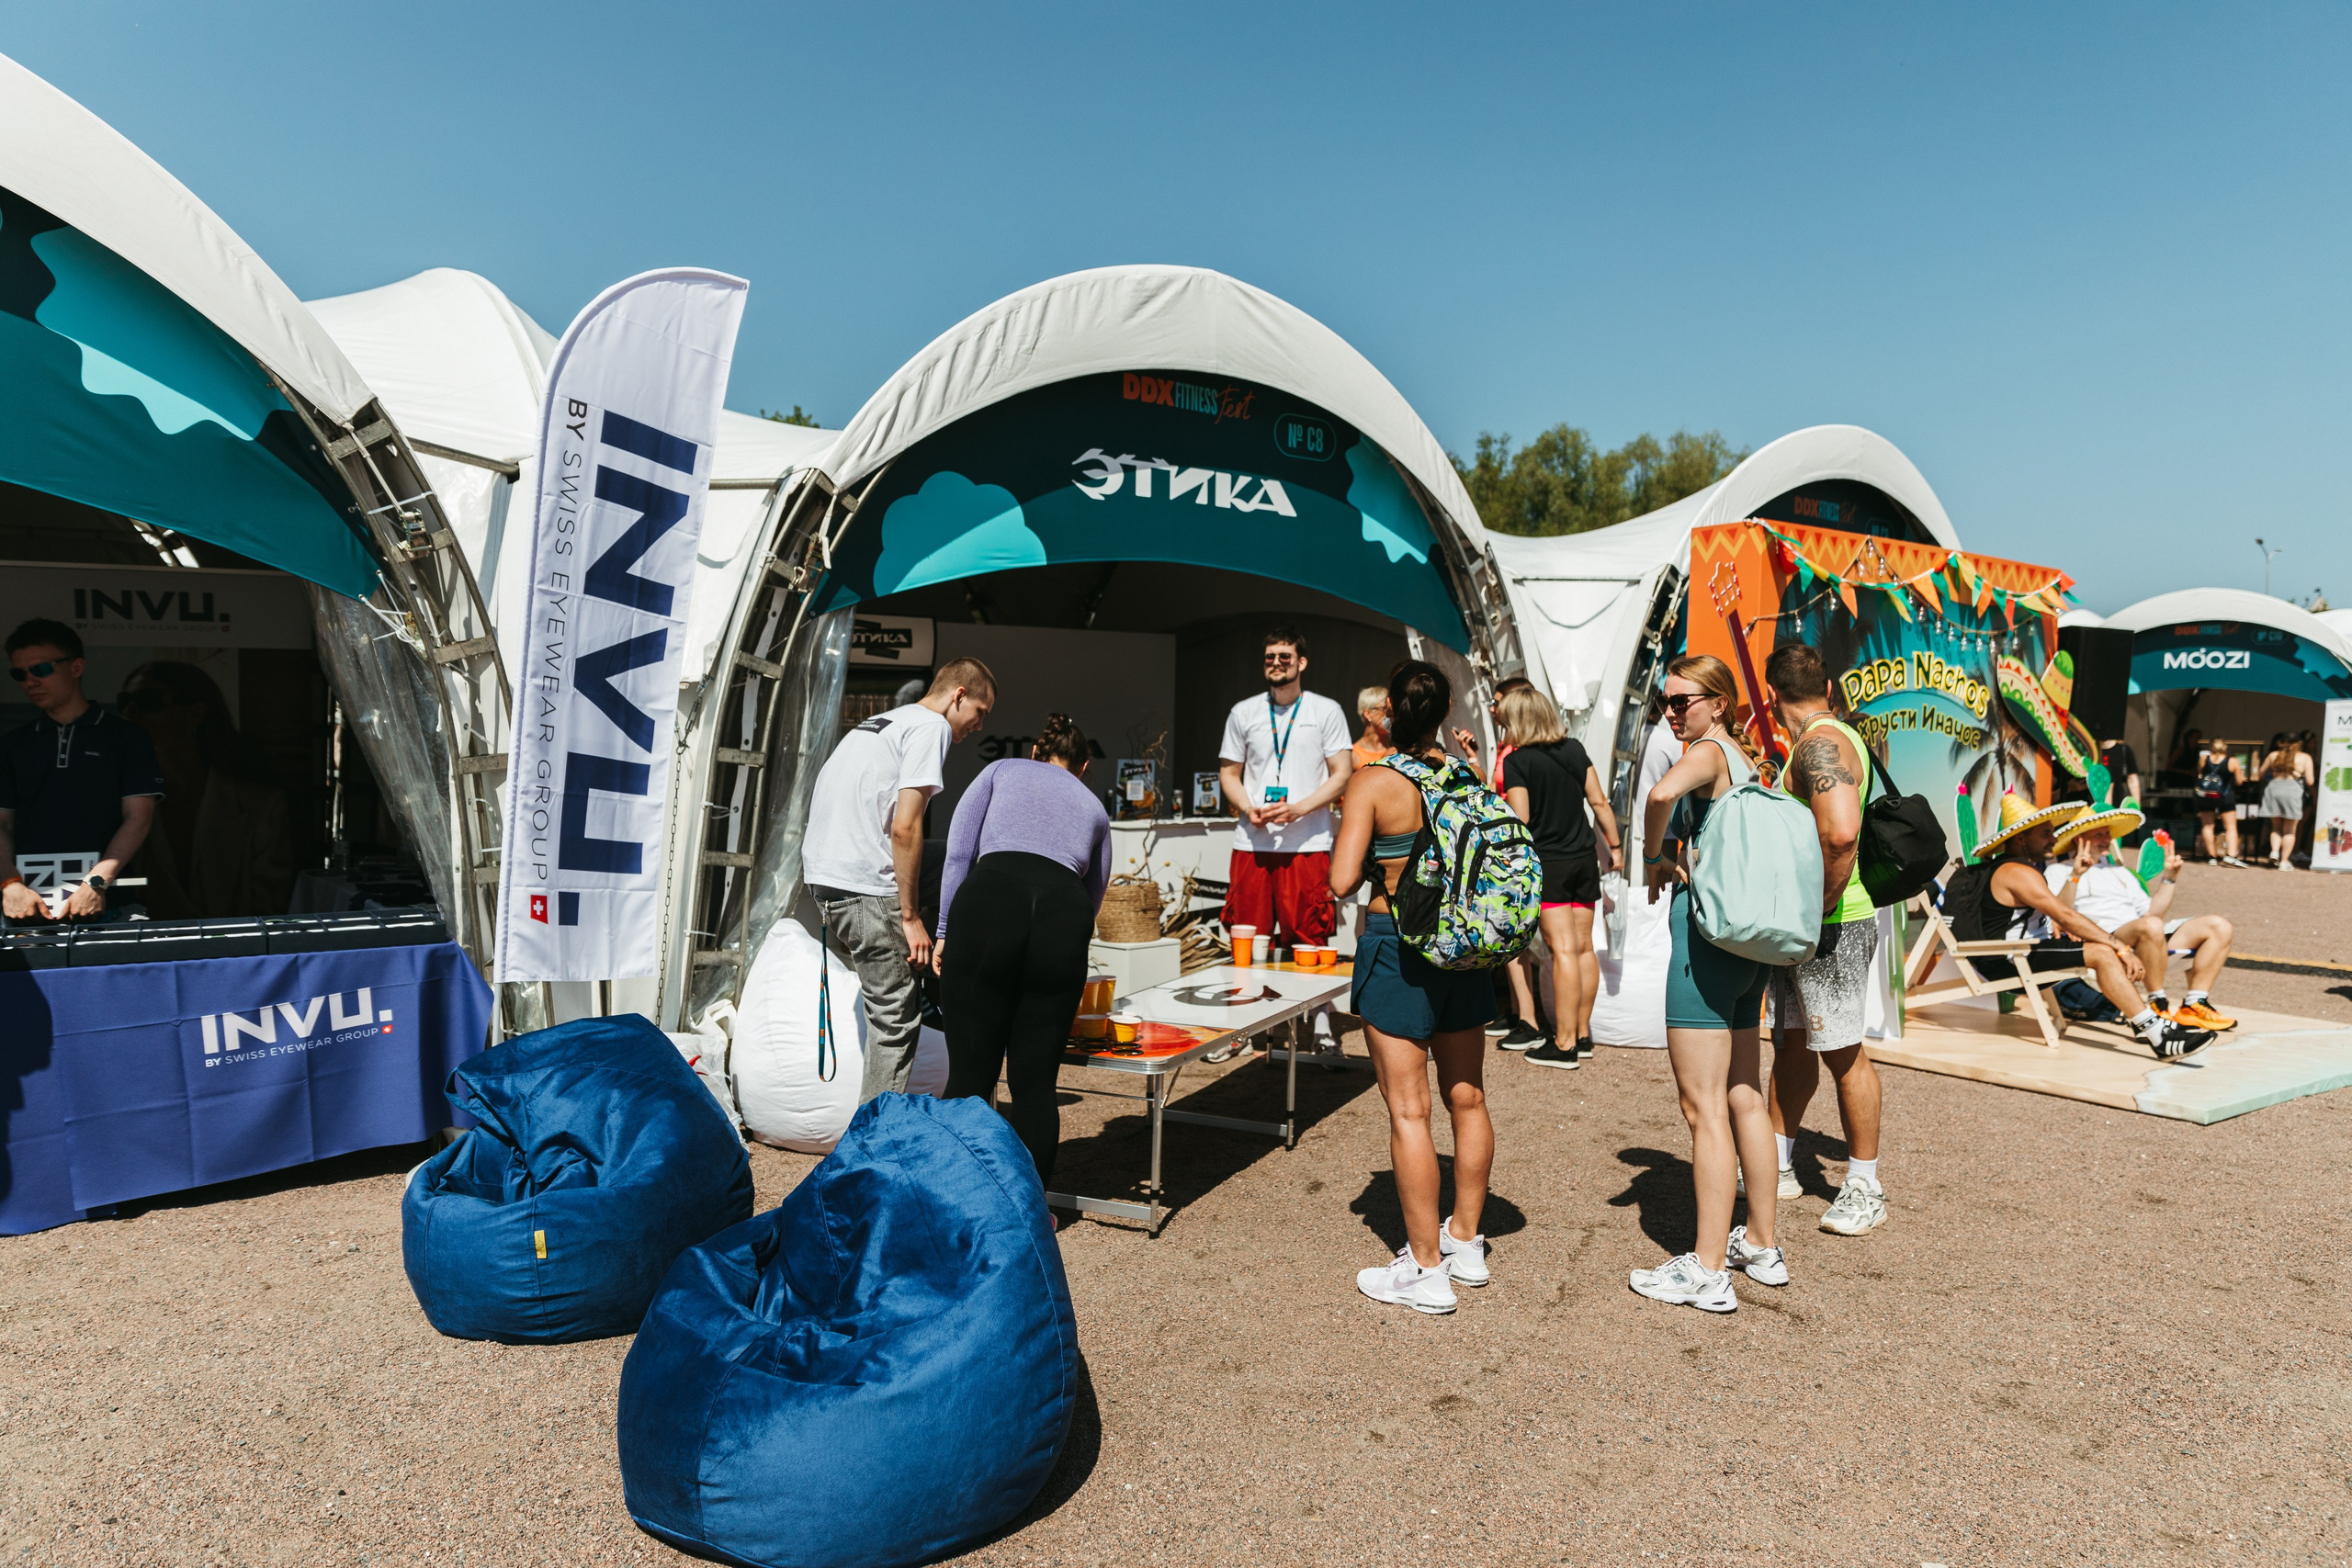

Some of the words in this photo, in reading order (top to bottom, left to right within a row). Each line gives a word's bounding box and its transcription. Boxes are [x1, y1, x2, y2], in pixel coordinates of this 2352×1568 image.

[566, 398, 588, 442] BY
[1123, 372, 1175, 407] DDX
[1175, 381, 1217, 415] FITNESS
[555, 449, 582, 557] SWISS
[1071, 447, 1297, 518] ЭТИКА
[538, 571, 570, 742] EYEWEAR
[1912, 650, 1991, 719] Nachos
[1921, 704, 1982, 751] Иначос
[531, 759, 552, 880] GROUP
[205, 1057, 221, 1068] BY
[225, 1049, 266, 1065] SWISS
[270, 1037, 332, 1056] EYEWEAR
[336, 1027, 379, 1043] GROUP
